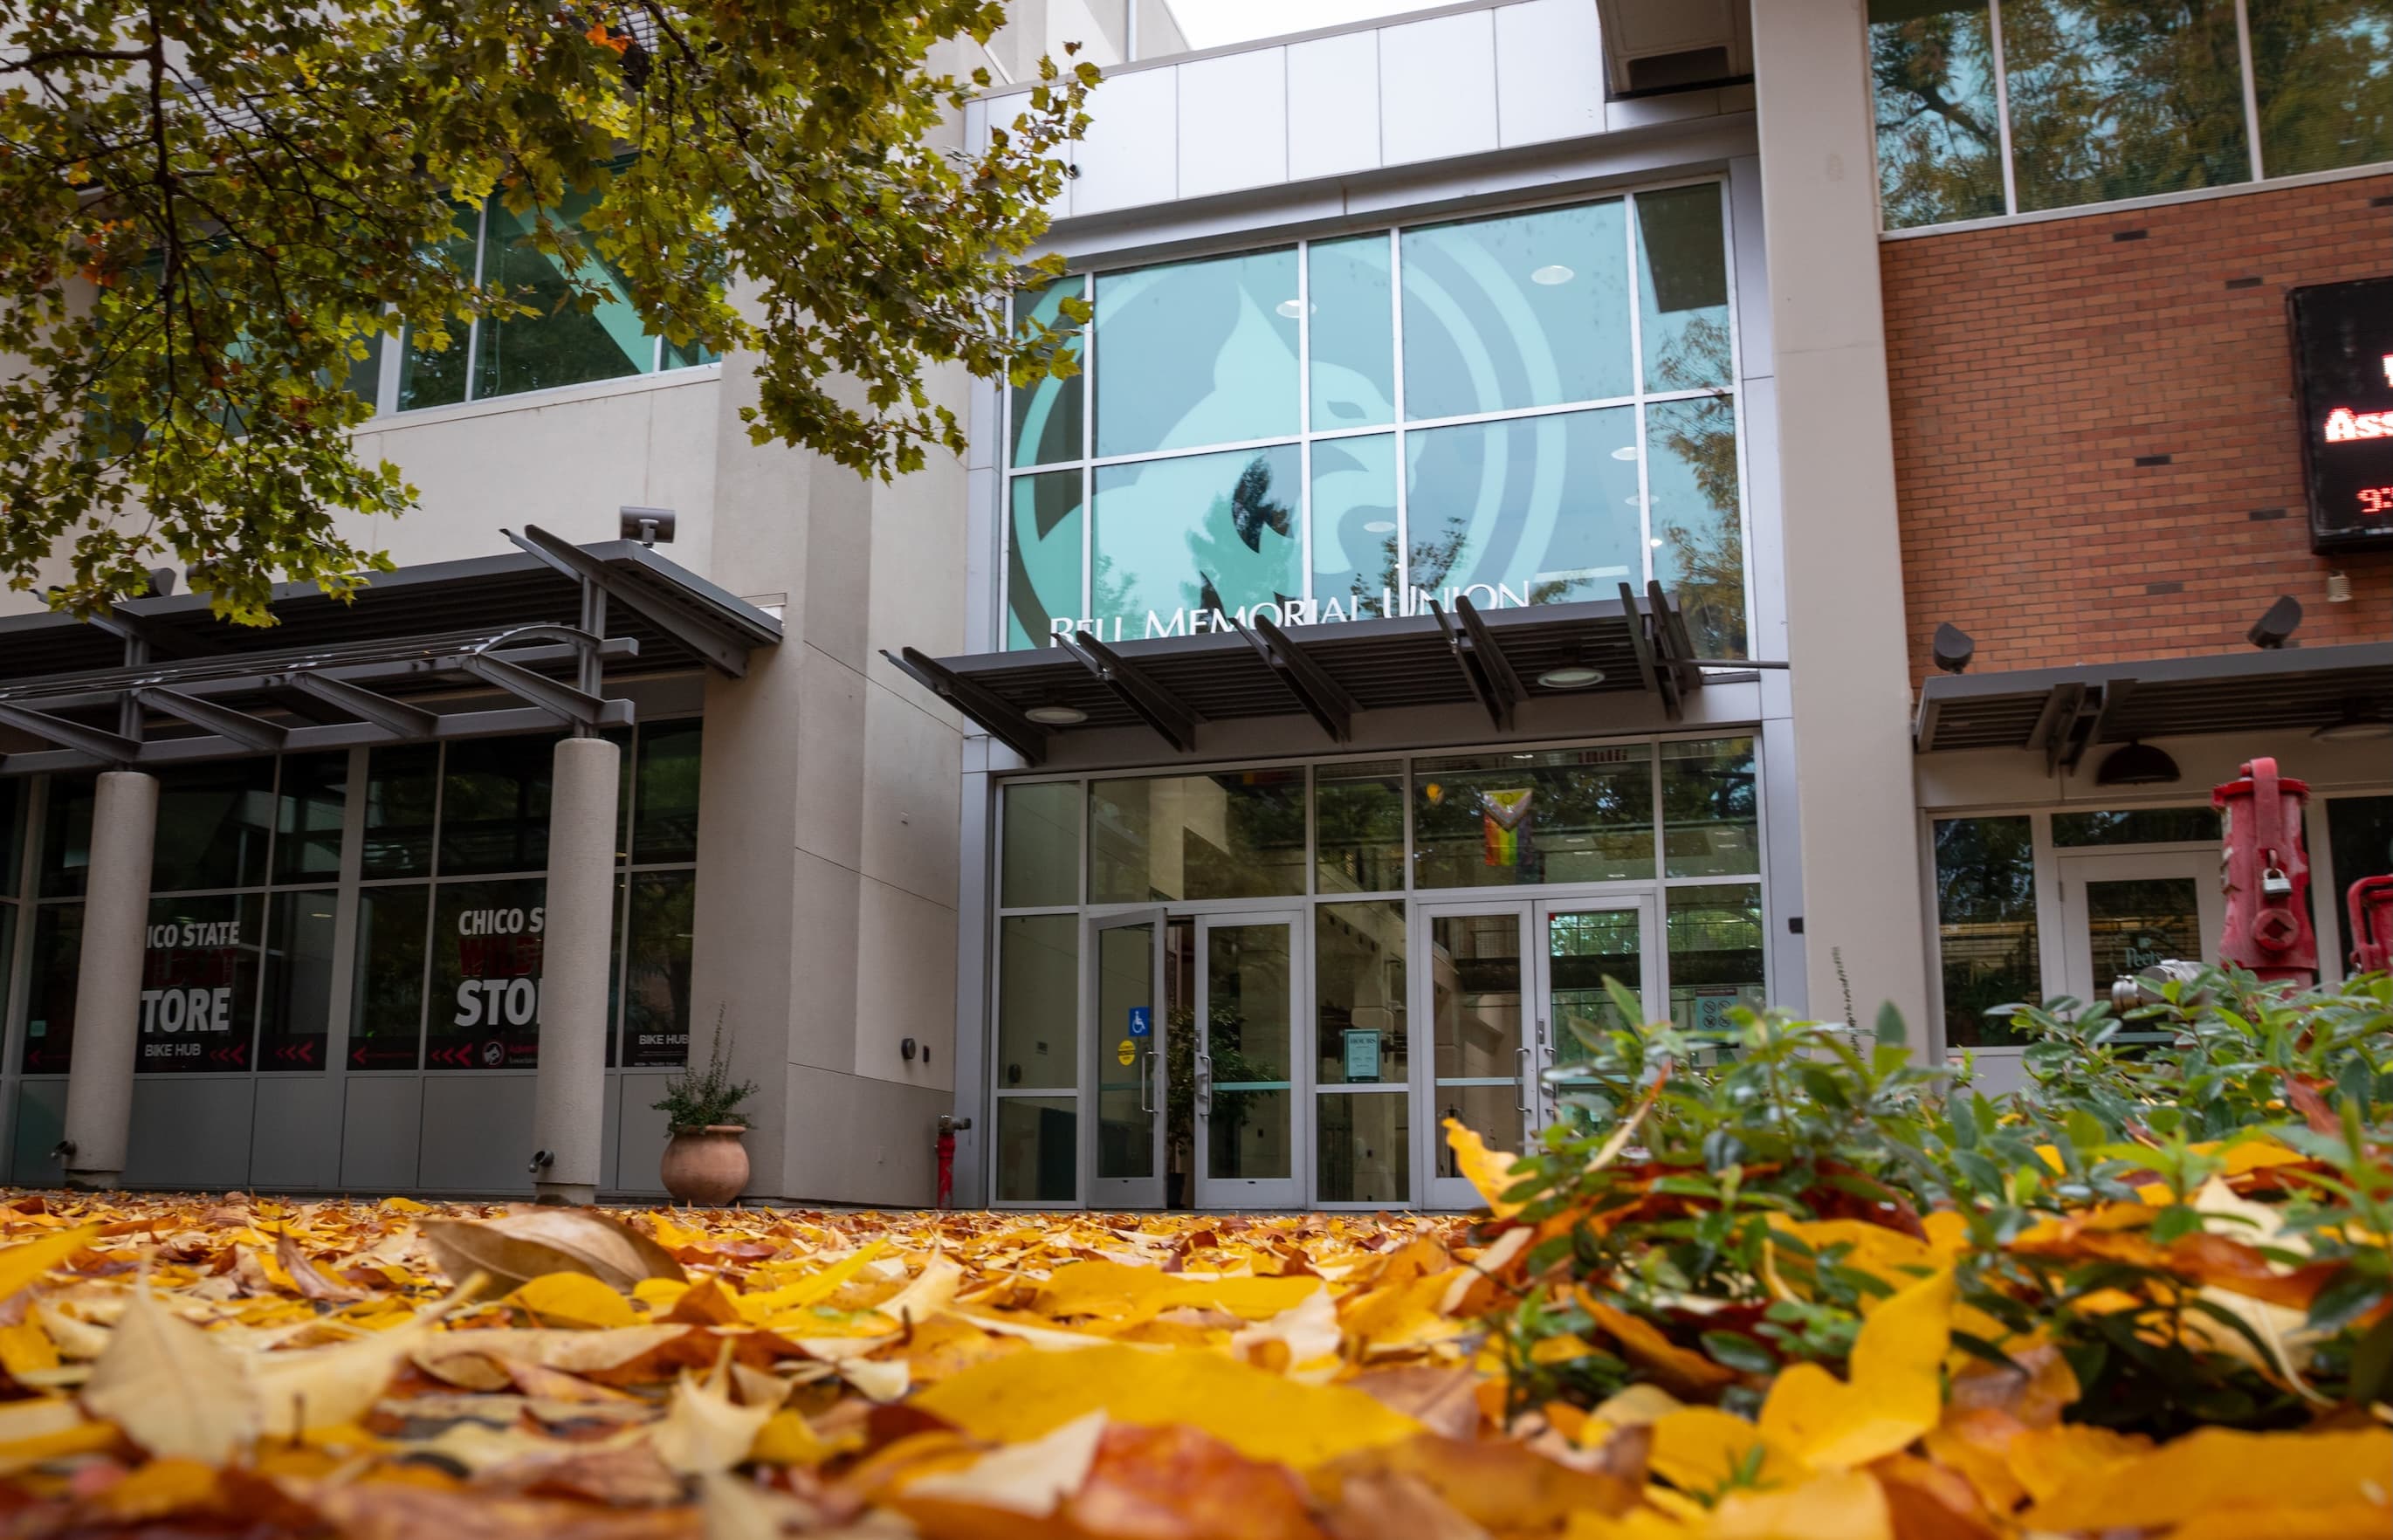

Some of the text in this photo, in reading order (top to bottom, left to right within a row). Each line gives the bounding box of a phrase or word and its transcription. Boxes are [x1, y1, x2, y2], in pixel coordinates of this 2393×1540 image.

[2356, 487, 2393, 513] 9:
[1145, 595, 1358, 640] MEMORIAL
[1383, 581, 1530, 618] UNION
[147, 921, 241, 949] ICO STATE
[457, 907, 525, 936] CHICO
[457, 936, 542, 978] WILD
[141, 987, 231, 1034] TORE
[453, 977, 542, 1027] STO
[144, 1042, 202, 1057] BIKE HUB
[638, 1034, 689, 1045] BIKE HUB
